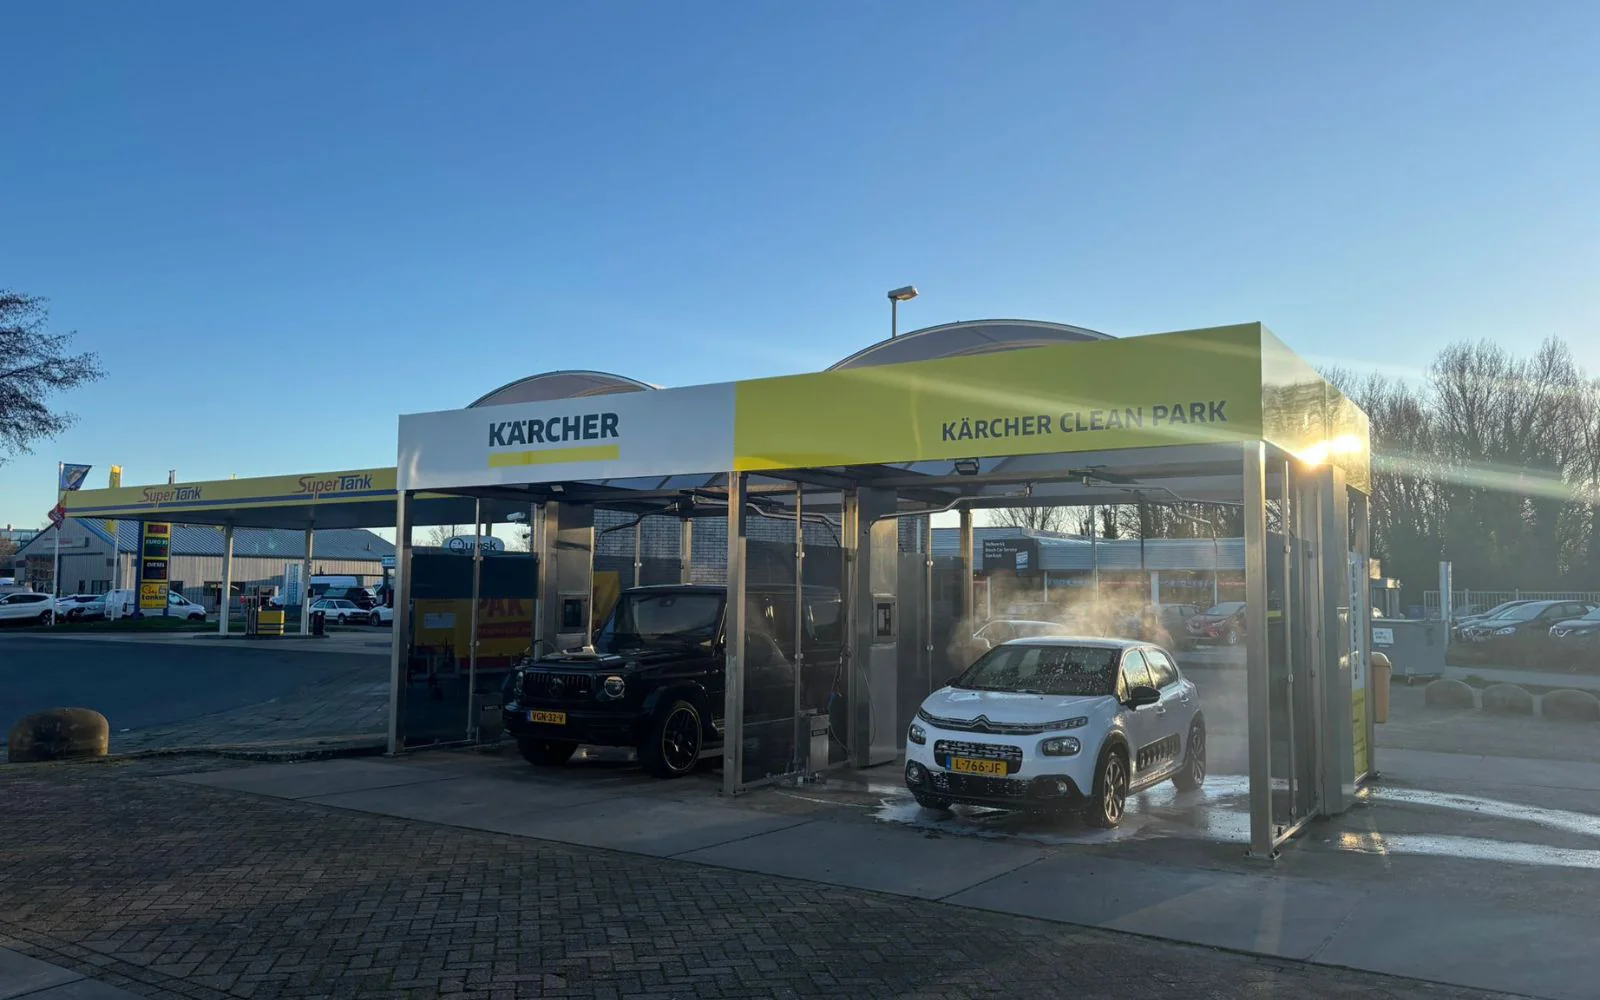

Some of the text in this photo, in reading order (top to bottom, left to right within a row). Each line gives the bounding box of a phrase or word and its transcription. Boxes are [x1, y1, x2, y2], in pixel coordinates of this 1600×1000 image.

[488, 412, 620, 448] KÄRCHER
[942, 399, 1228, 442] KÄRCHER CLEAN PARK
[137, 486, 202, 508] SuperTank
[292, 473, 374, 500] SuperTank
[955, 759, 1001, 774] L-766-JF
